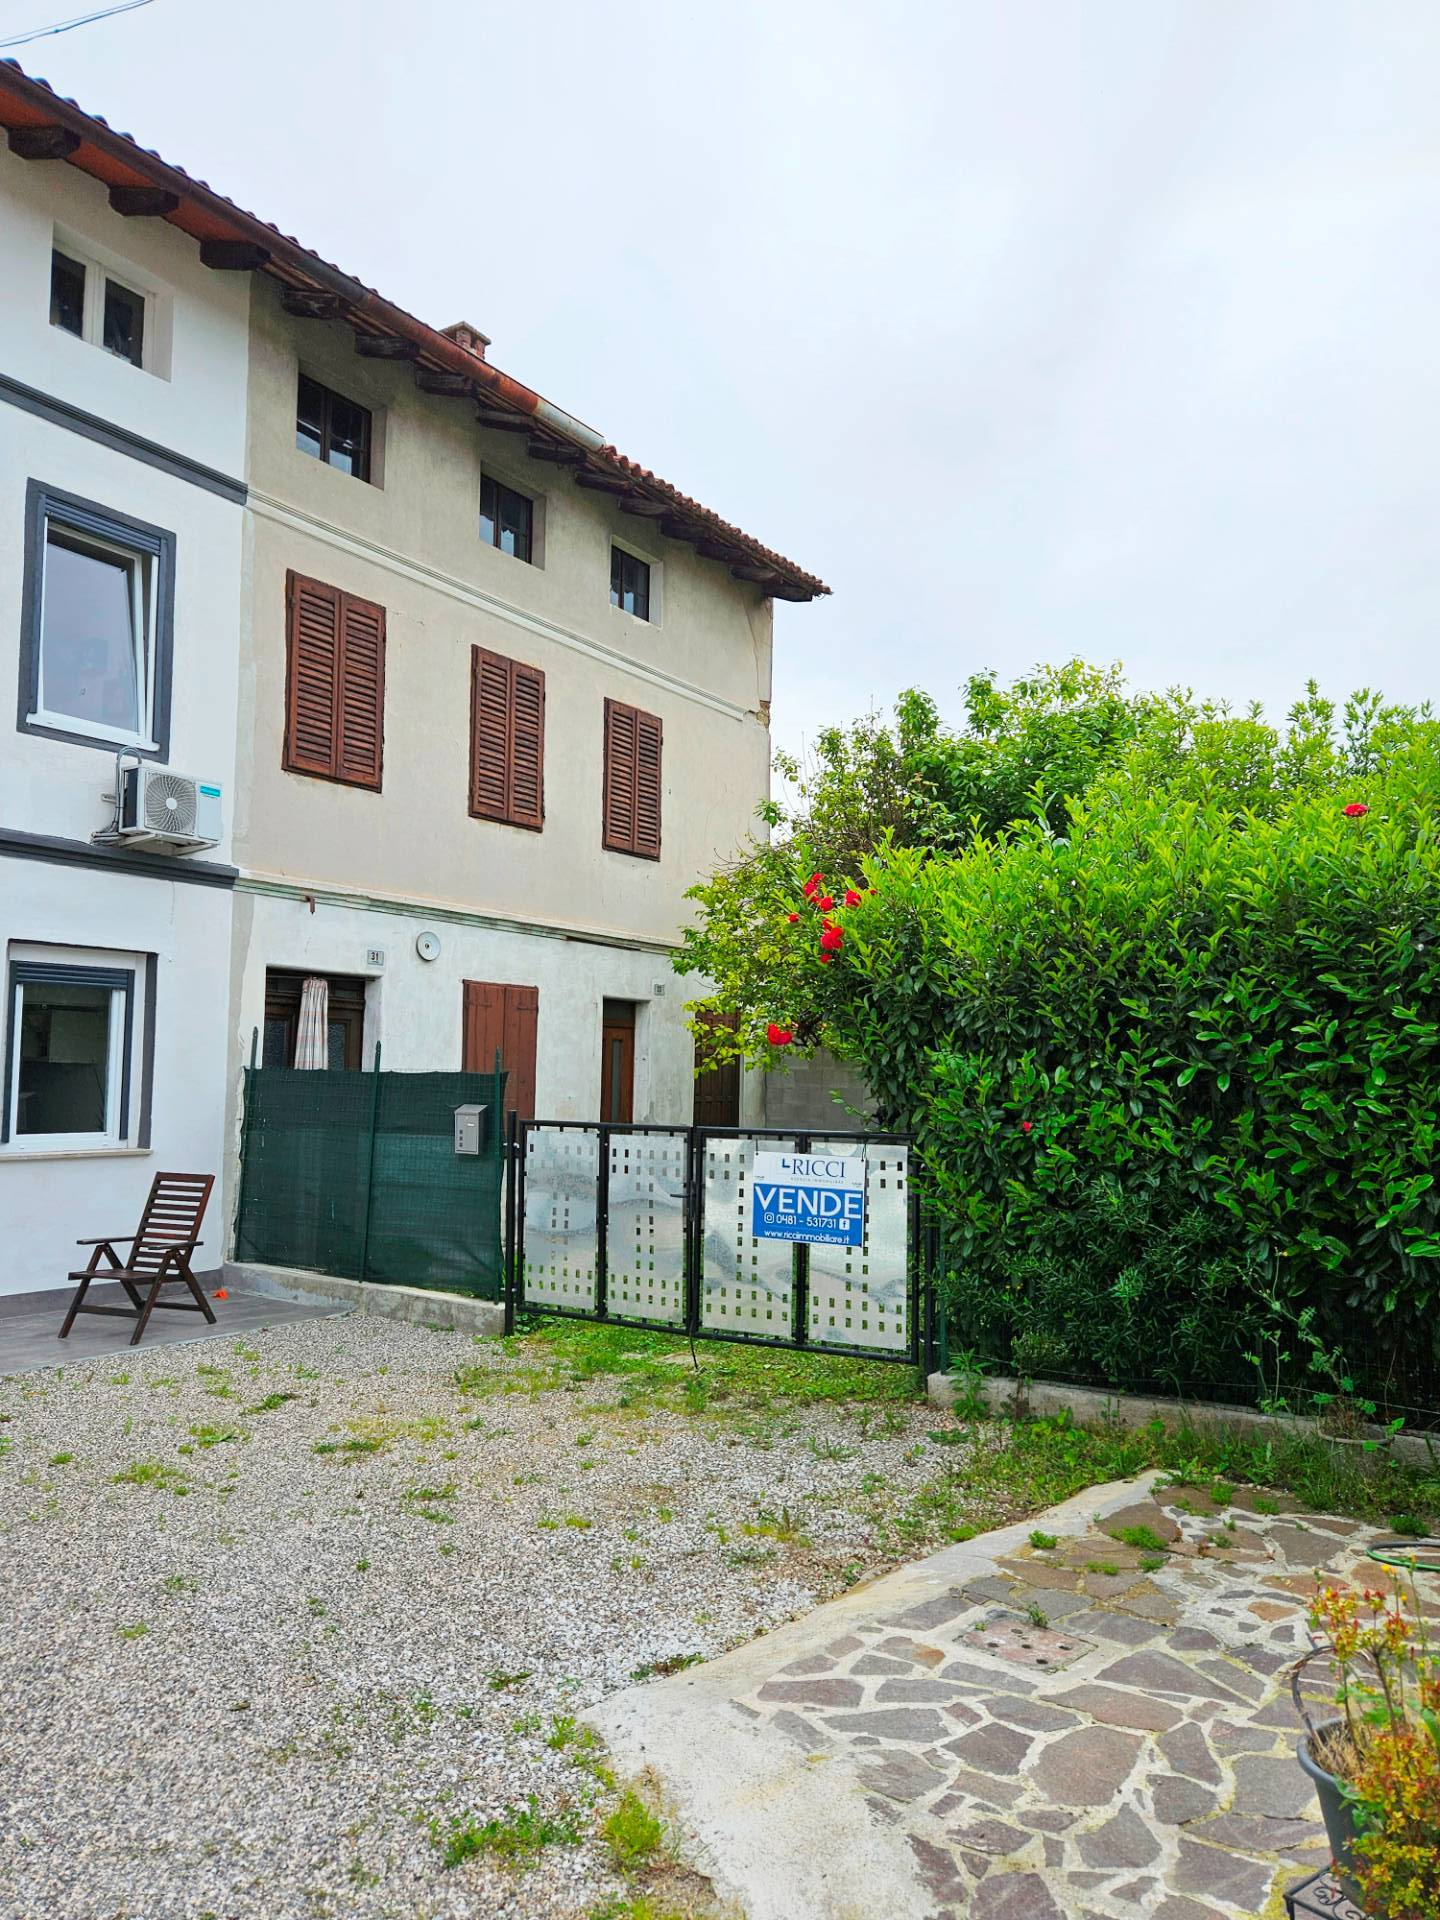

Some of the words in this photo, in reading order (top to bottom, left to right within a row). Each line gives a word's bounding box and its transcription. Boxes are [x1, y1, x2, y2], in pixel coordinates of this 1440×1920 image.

[371, 952, 379, 960] 31
[792, 1158, 846, 1178] RICCI
[754, 1186, 862, 1219] VENDE
[776, 1214, 797, 1225] 0481
[806, 1217, 837, 1229] 531731
